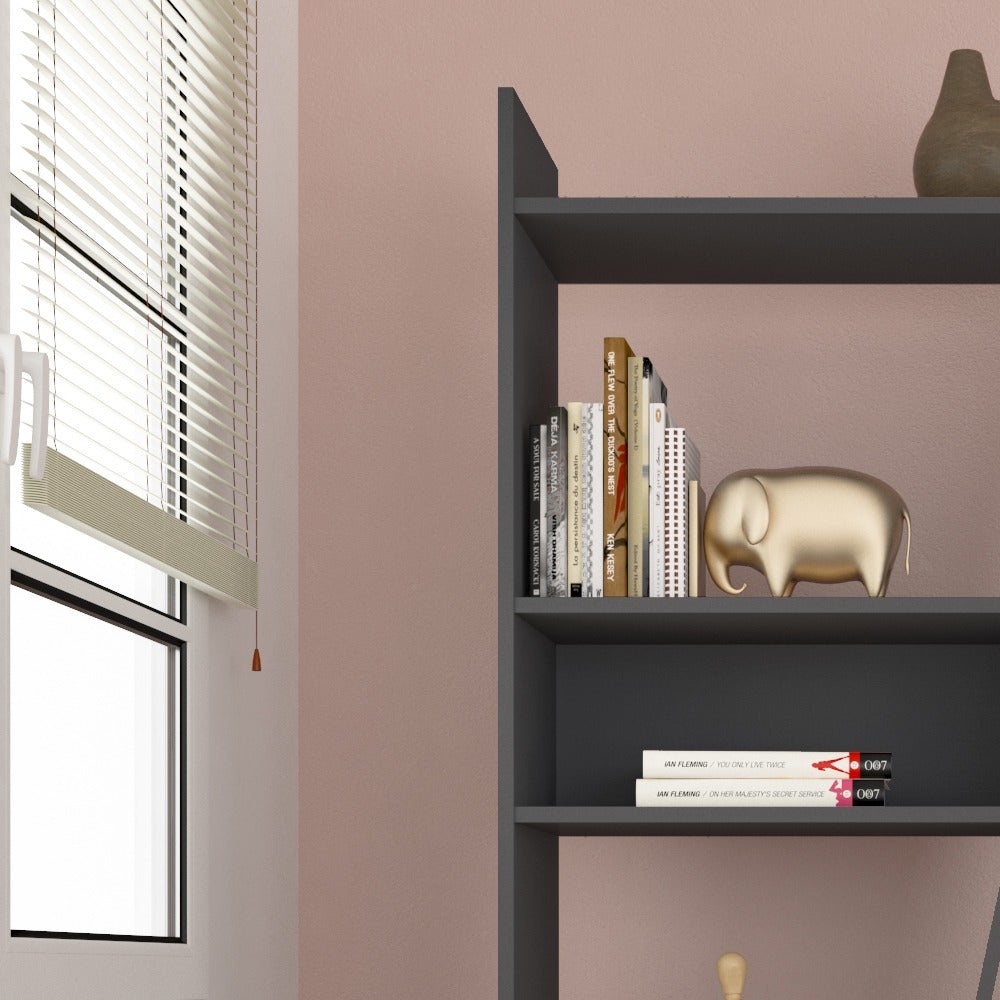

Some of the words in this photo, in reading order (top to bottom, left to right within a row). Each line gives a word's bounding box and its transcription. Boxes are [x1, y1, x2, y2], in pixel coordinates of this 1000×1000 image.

[573, 485, 578, 498] du
[606, 533, 614, 550] KEN
[606, 554, 614, 582] KESEY
[864, 760, 887, 770] 007
[856, 788, 880, 799] 007
